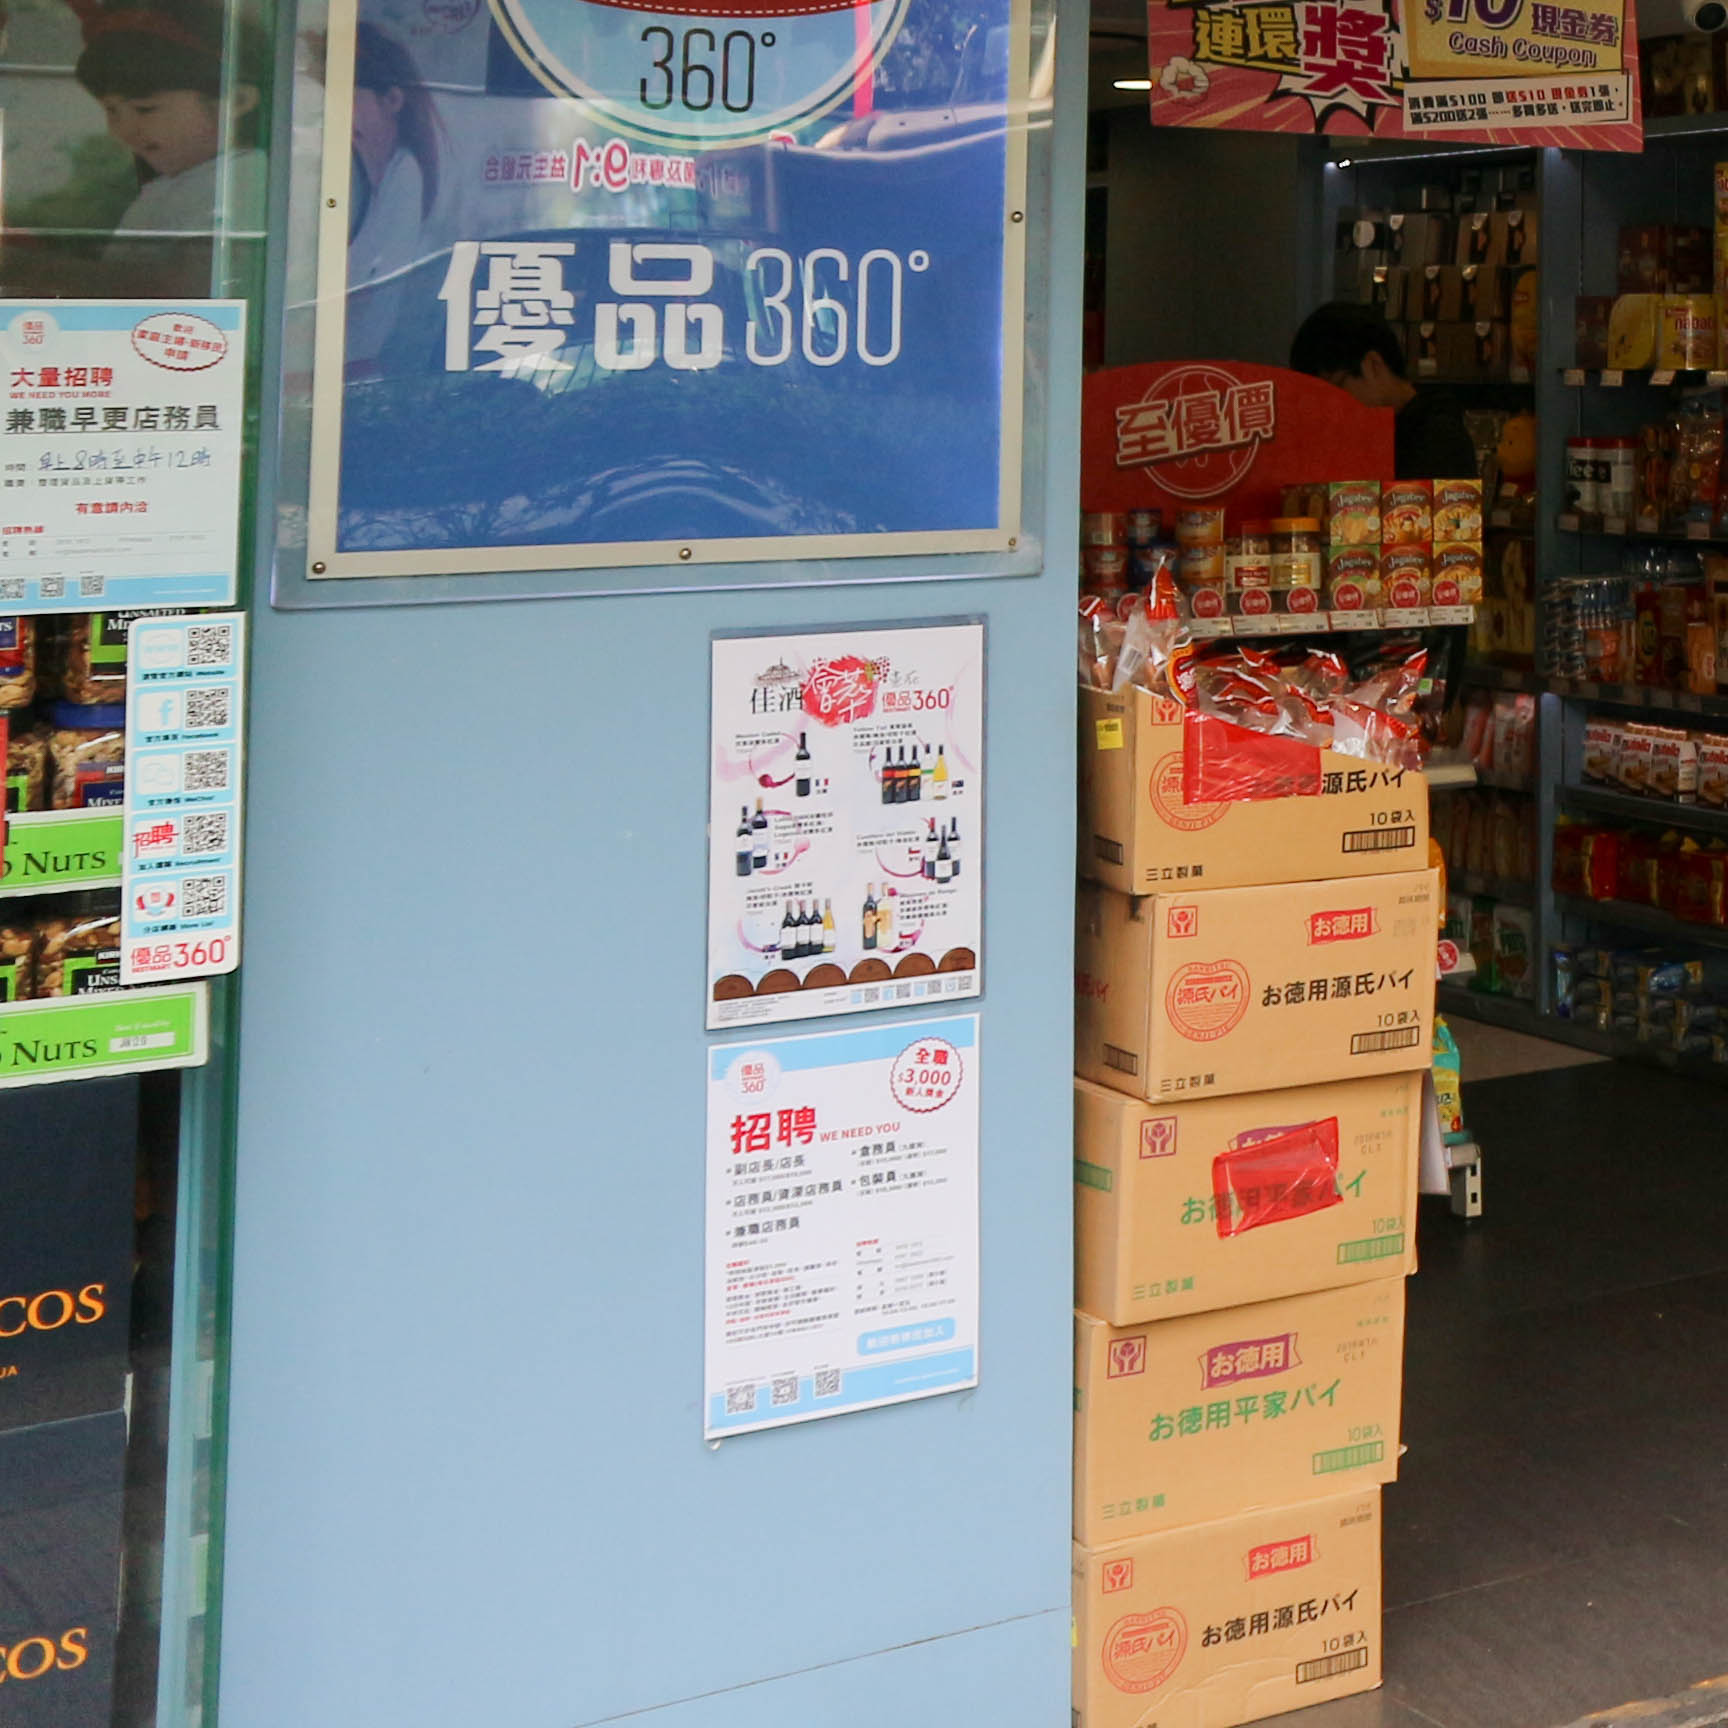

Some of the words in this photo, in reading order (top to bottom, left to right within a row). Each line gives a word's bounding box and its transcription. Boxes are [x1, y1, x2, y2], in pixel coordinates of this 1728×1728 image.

[1531, 3, 1620, 47] 現金券
[1450, 31, 1507, 61] Cash
[1513, 38, 1597, 68] Coupon
[10, 366, 114, 389] 大量招聘
[29, 391, 55, 399] NEED
[59, 390, 79, 399] YOU
[6, 404, 220, 433] 兼職早更店務員
[1116, 381, 1275, 467] 至優價
[1370, 810, 1416, 827] 10袋入
[1145, 864, 1204, 882] 三立製菓
[1314, 913, 1369, 938] お徳用
[1177, 983, 1240, 1006] 源氏パイ
[1262, 968, 1415, 1008] お徳用源氏パイ
[1377, 1008, 1422, 1028] 10袋入
[915, 1048, 949, 1066] 全職
[898, 1068, 952, 1086] $3,000
[1160, 1073, 1217, 1093] 三立製菓
[730, 1105, 817, 1155] 招聘
[820, 1131, 839, 1143] WE
[841, 1125, 873, 1140] NEED
[875, 1121, 901, 1134] YOU
[1132, 1276, 1196, 1301] 三立製菓
[1210, 1340, 1286, 1378] お徳用
[1148, 1377, 1342, 1443] お徳用平家パイ
[1347, 1422, 1384, 1442] 10袋入
[1101, 1492, 1167, 1520] 三立製菓
[1250, 1542, 1308, 1573] お徳用
[1200, 1588, 1360, 1649] お徳用源氏パイ
[1112, 1628, 1177, 1660] 源氏パイ
[1321, 1629, 1369, 1654] 10袋入
